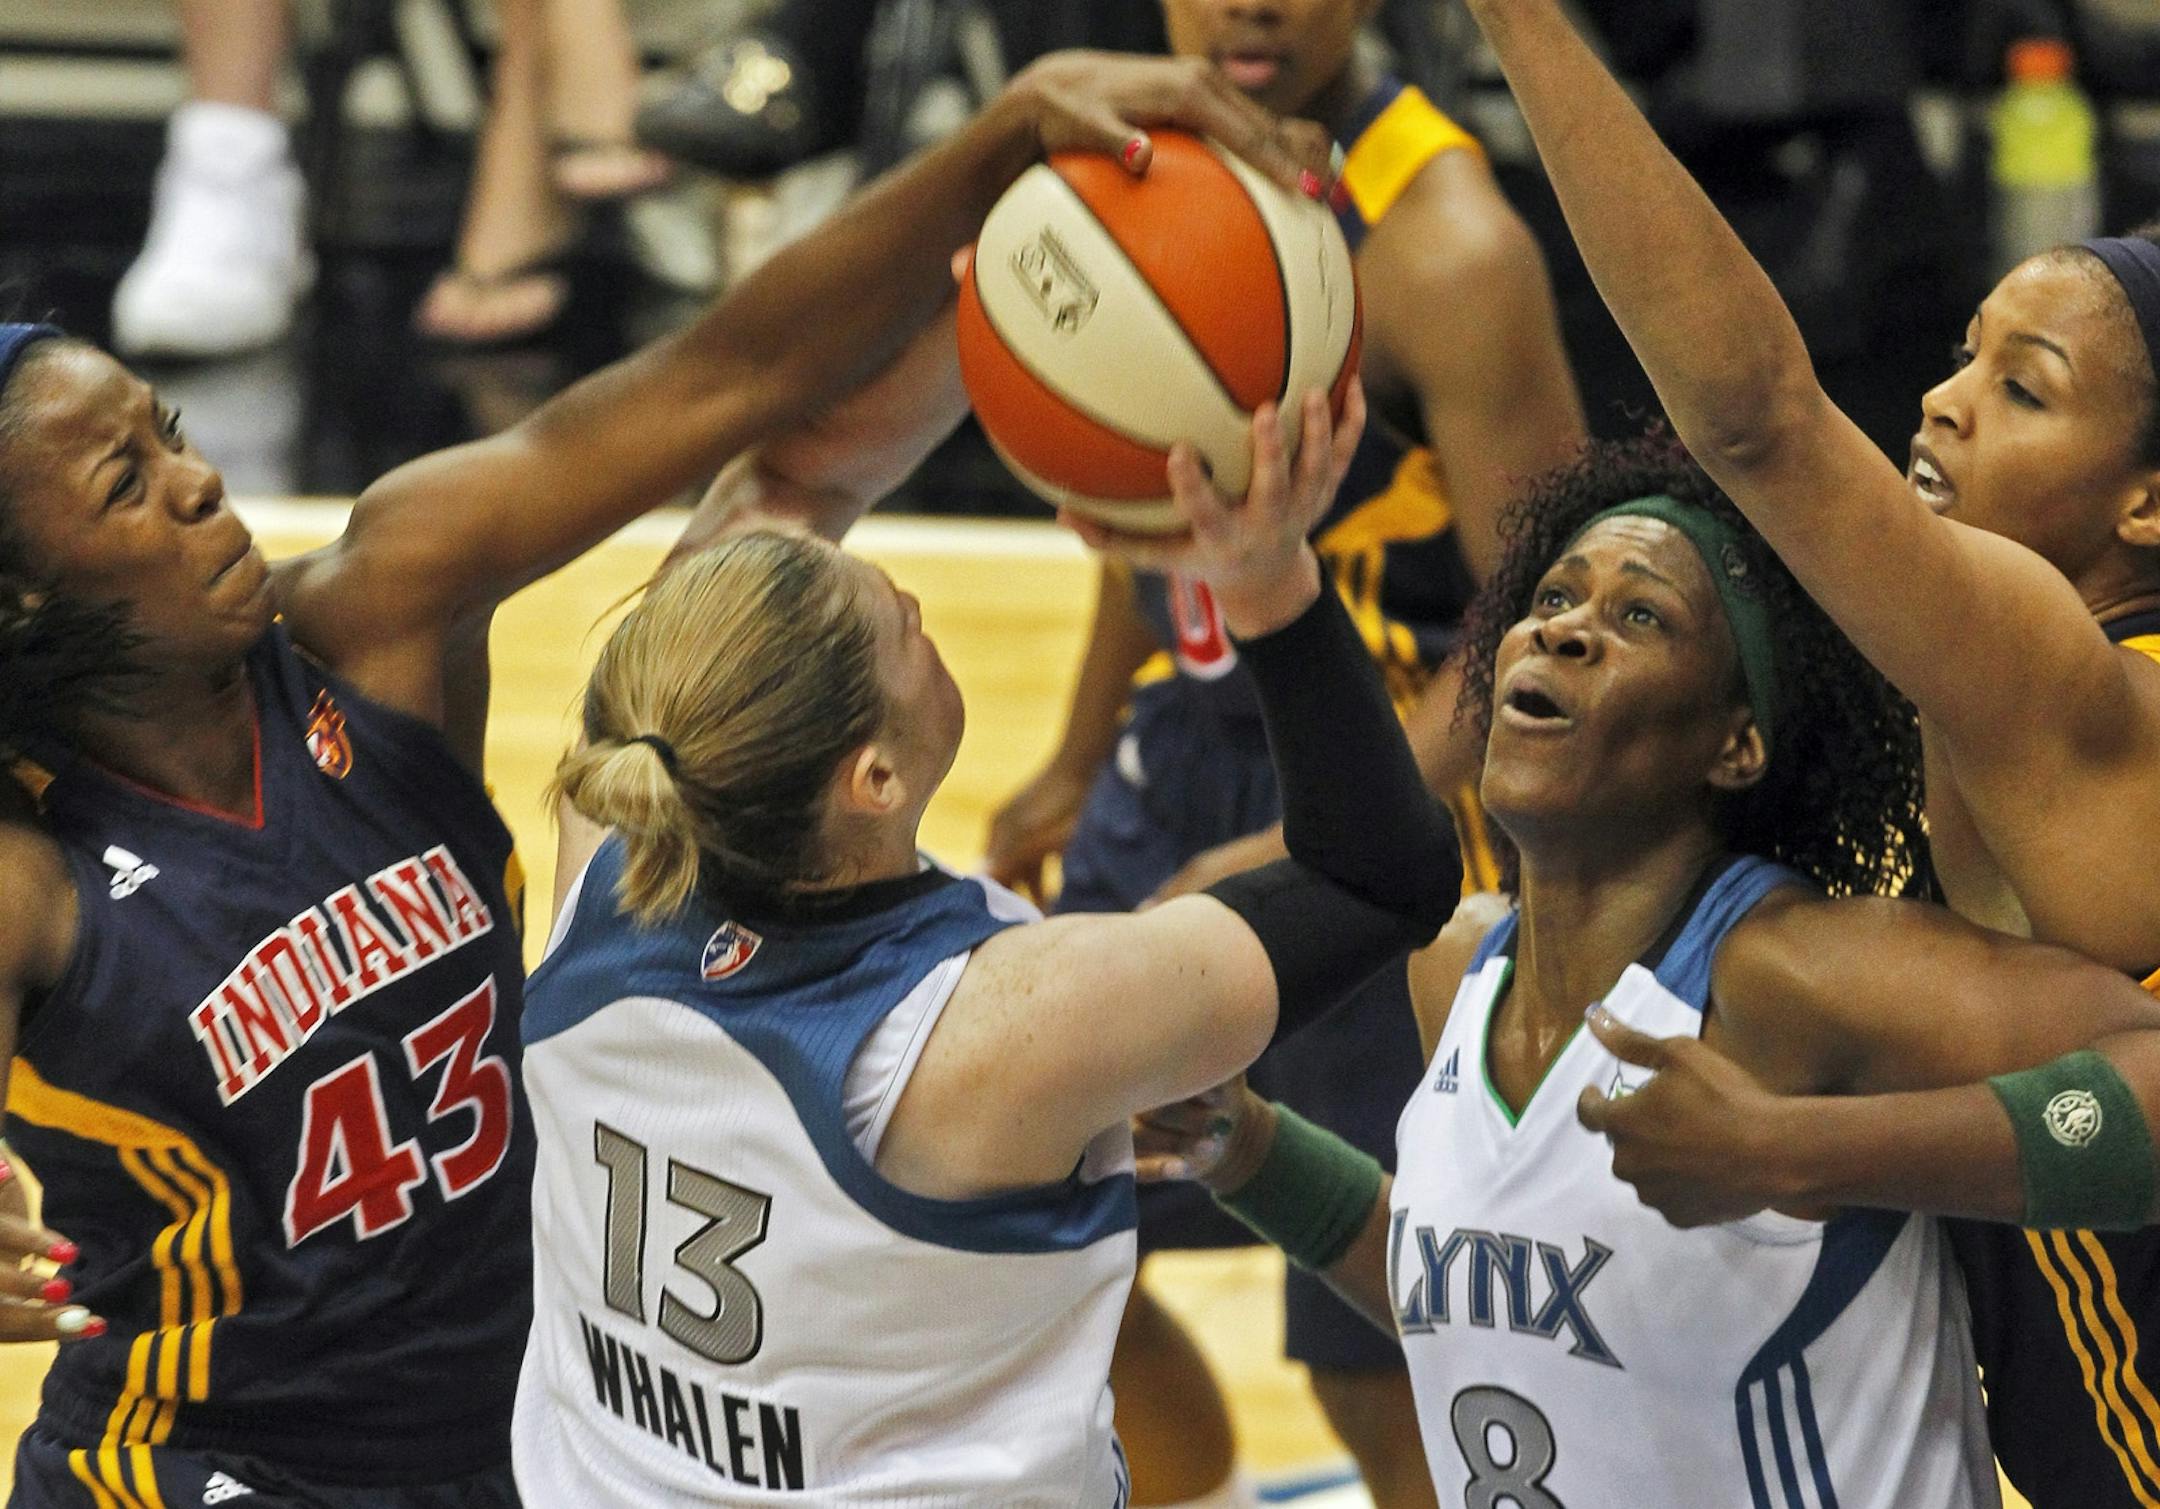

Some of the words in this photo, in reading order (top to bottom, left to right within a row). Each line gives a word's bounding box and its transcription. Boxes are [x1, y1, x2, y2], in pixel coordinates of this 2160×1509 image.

[188, 843, 495, 1108] INDIANA
[282, 972, 513, 1249] 43
[594, 1118, 772, 1365] 13
[1388, 1206, 1627, 1371] LYNX
[579, 1310, 804, 1491] WHALEN
[1451, 1384, 1567, 1509] 8
